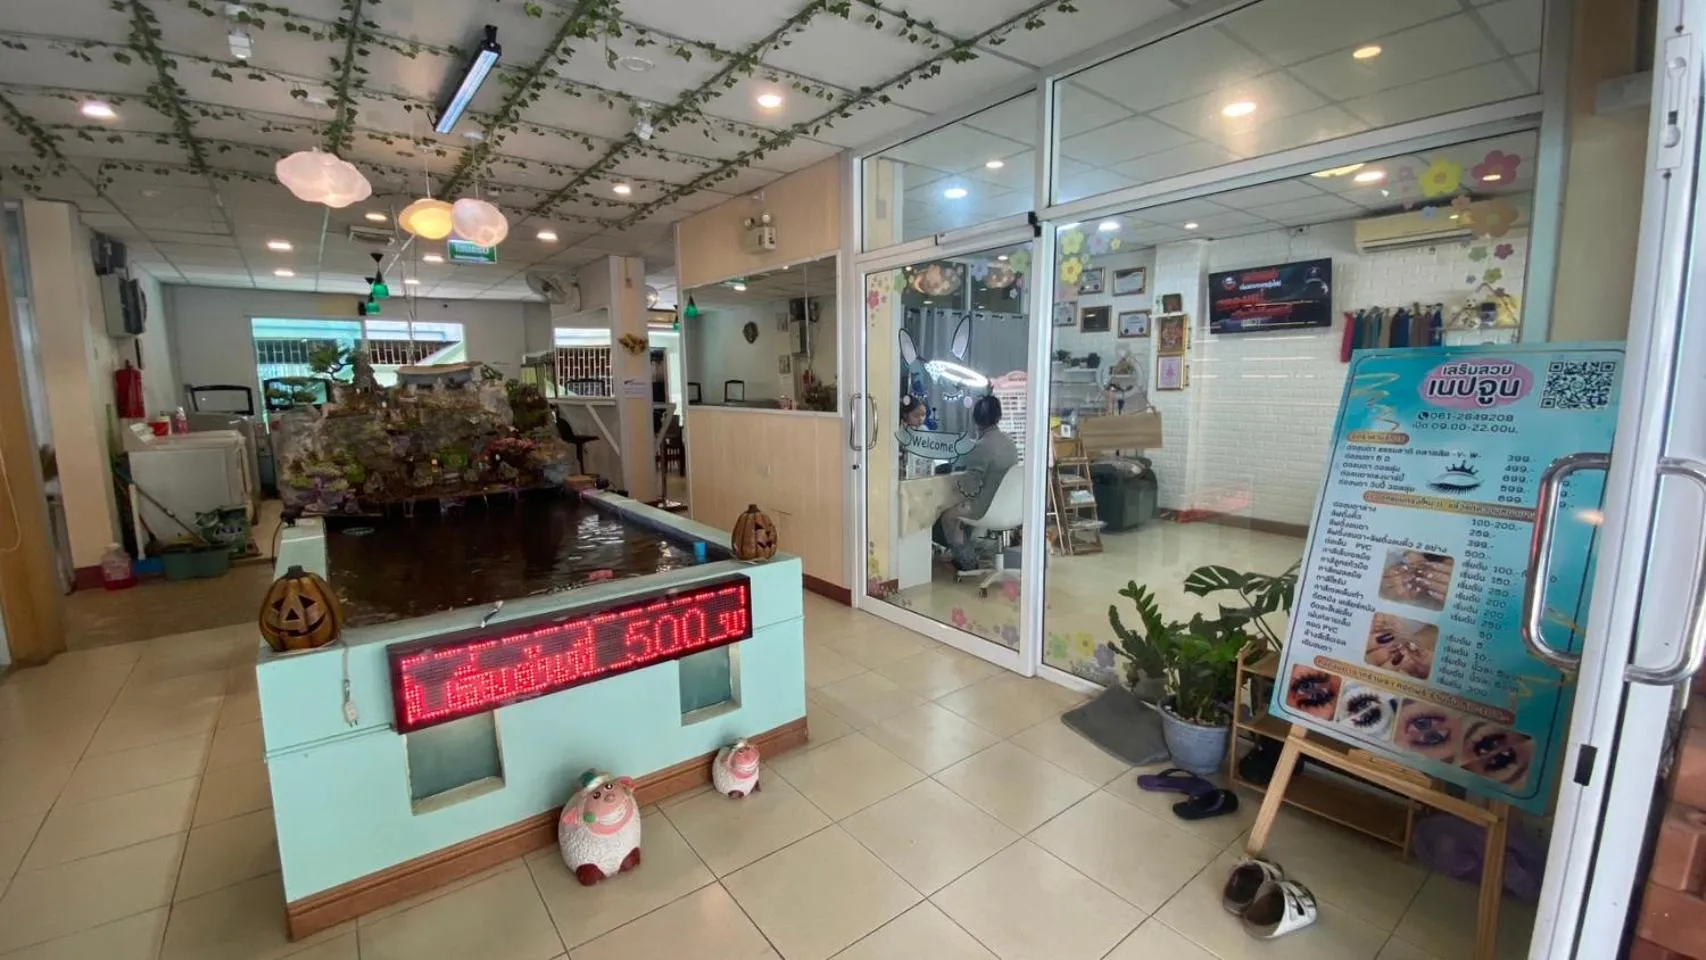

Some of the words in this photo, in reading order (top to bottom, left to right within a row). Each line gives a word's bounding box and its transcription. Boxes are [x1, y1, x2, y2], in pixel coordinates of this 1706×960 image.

[1442, 363, 1513, 375] เสริมสวย
[1428, 377, 1520, 405] เนปจูน
[1430, 412, 1514, 422] 061-2649208
[912, 436, 954, 453] Welcome
[625, 608, 704, 659] 500
